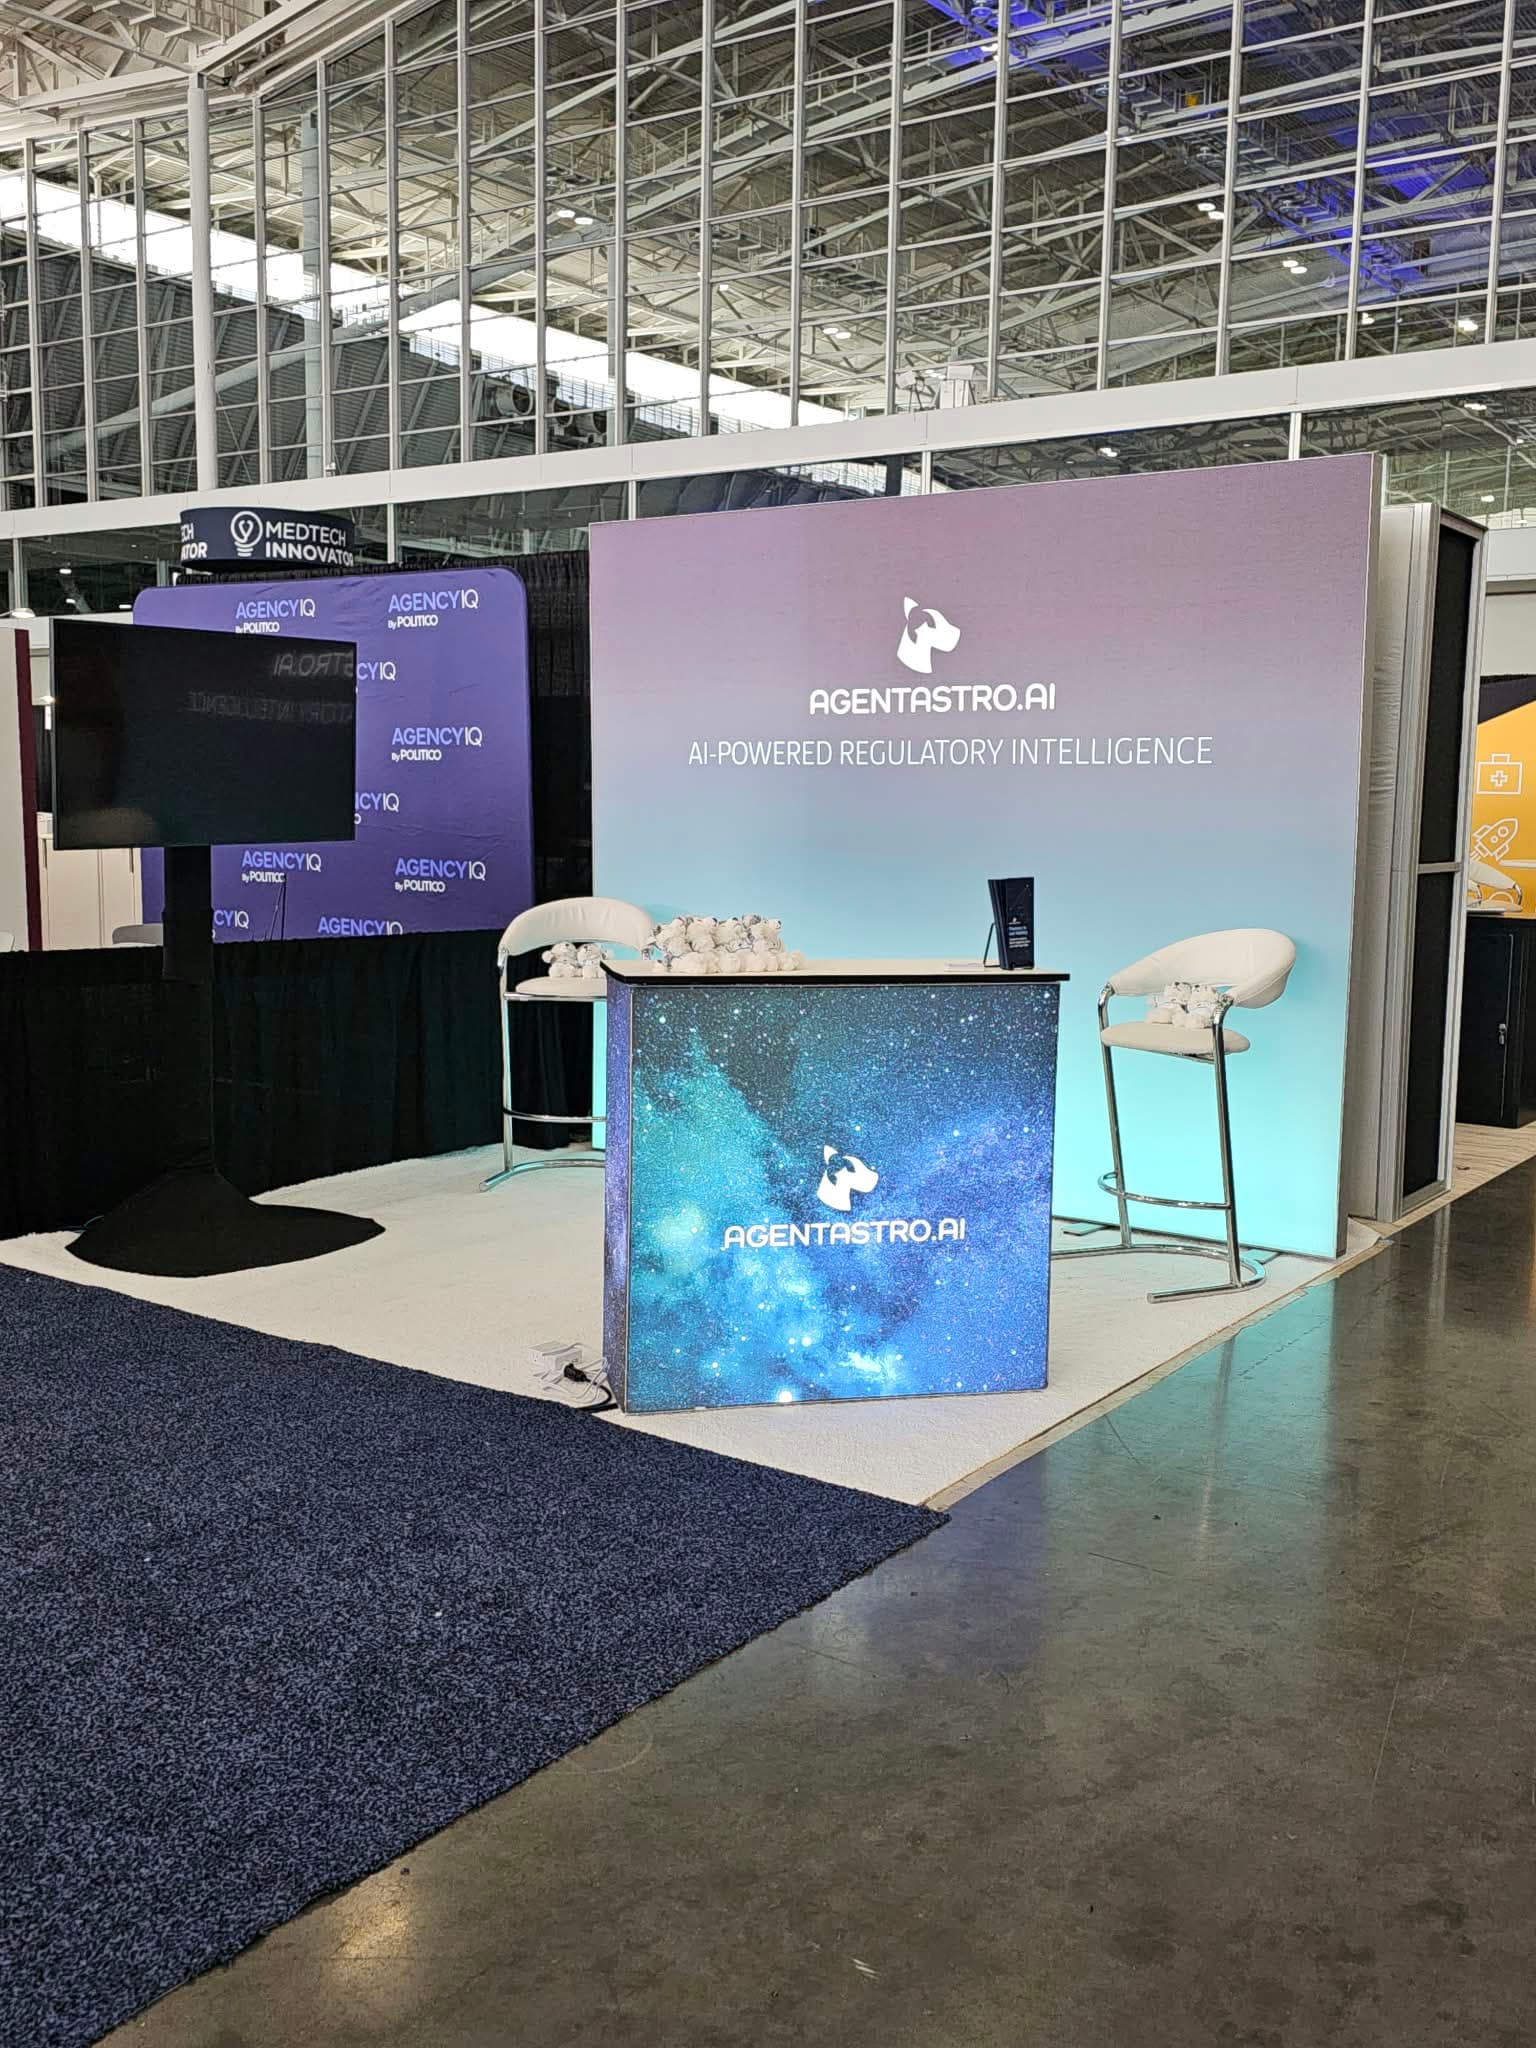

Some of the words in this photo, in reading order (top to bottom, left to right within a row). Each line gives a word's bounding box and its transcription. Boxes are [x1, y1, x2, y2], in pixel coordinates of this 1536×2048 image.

[265, 521, 346, 547] MEDTECH
[265, 541, 354, 567] INNOVATOR
[235, 598, 316, 619] AGENCYIQ
[387, 588, 480, 613] AGENCYIQ
[243, 621, 280, 633] POLITICO
[397, 614, 439, 628] POLITICO
[809, 682, 1056, 716] AGENTASTRO.AI
[391, 726, 483, 747] AGENCYIQ
[400, 749, 442, 761] POLITICO
[688, 740, 833, 766] AI-POWERED
[839, 738, 1004, 766] REGULATORY
[1012, 736, 1214, 766] INTELLIGENCE
[241, 850, 322, 872] AGENCYIQ
[394, 857, 487, 881] AGENCYIQ
[403, 879, 446, 893] POLITICO
[723, 1217, 966, 1249] AGENTASTRO.AI
